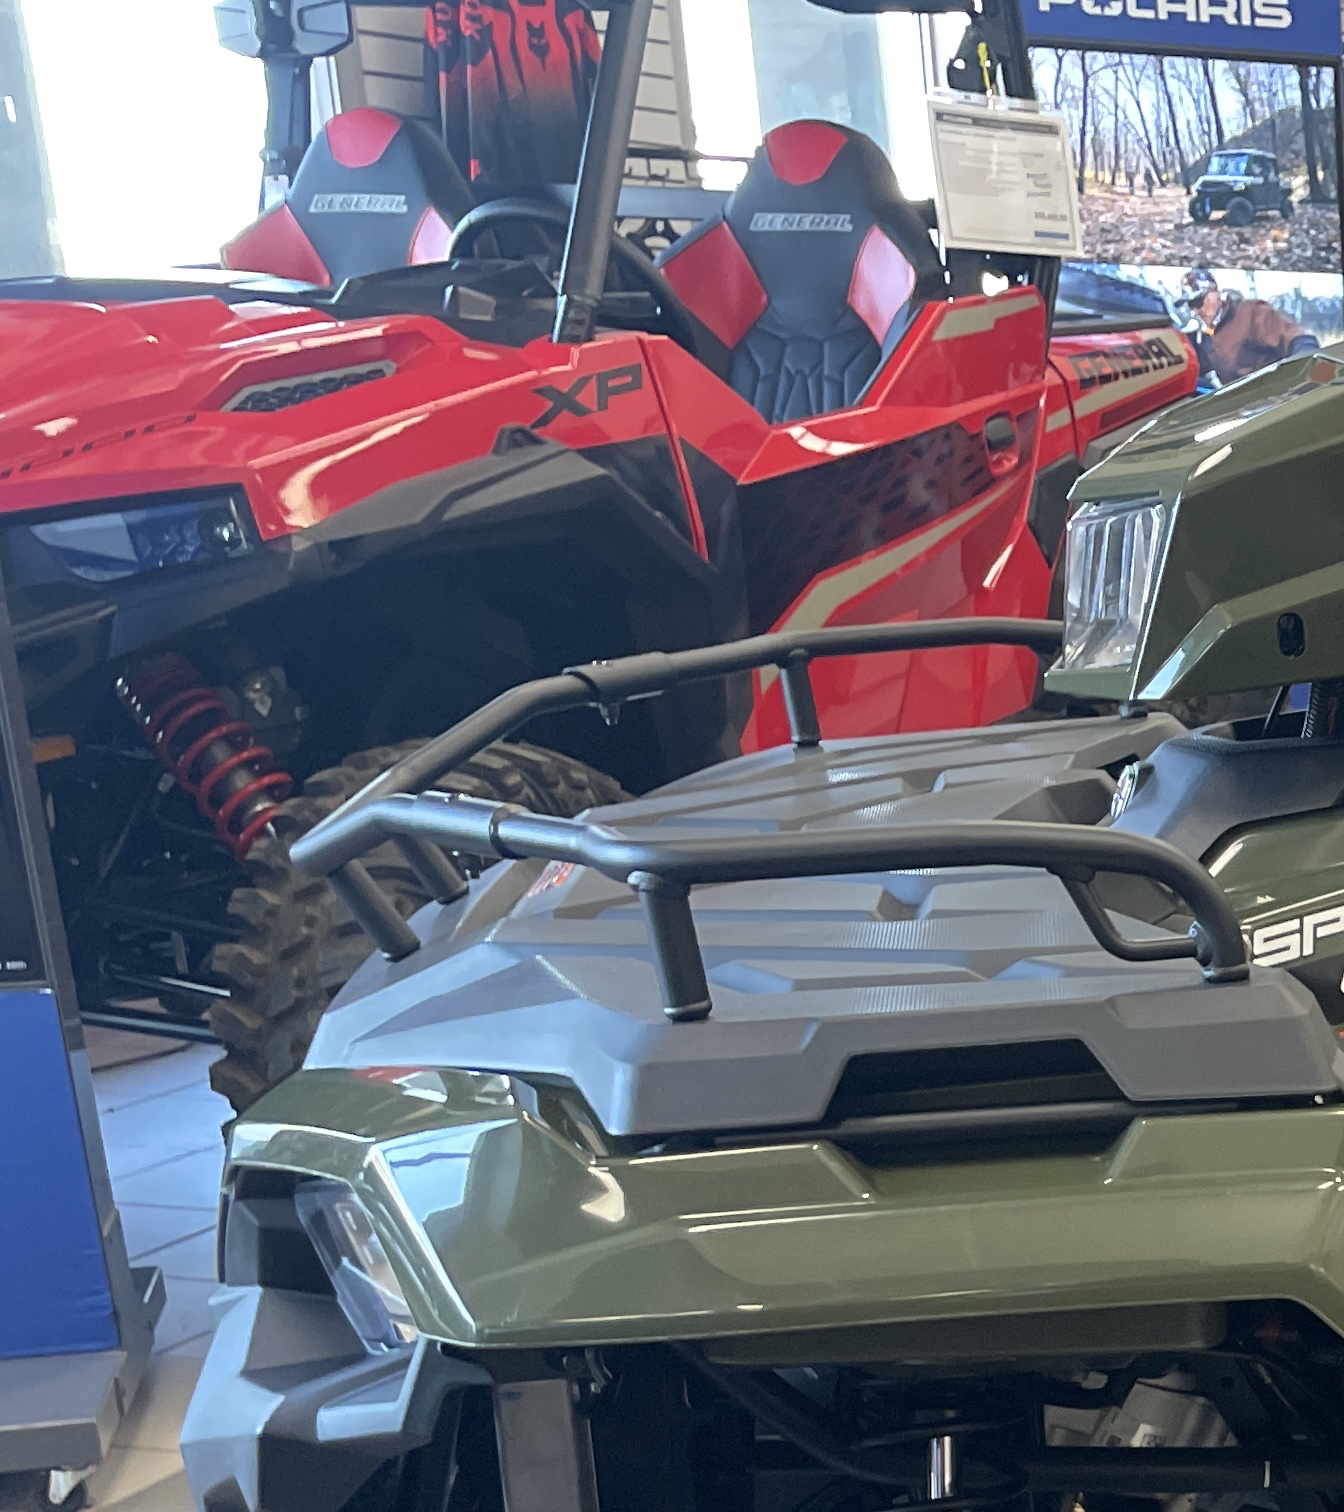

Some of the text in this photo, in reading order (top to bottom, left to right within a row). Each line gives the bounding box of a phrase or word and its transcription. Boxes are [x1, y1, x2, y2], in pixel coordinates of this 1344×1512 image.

[308, 193, 409, 213] GENERAL
[749, 212, 854, 232] GENERAL
[1068, 337, 1185, 390] GENERAL
[529, 362, 643, 430] XP
